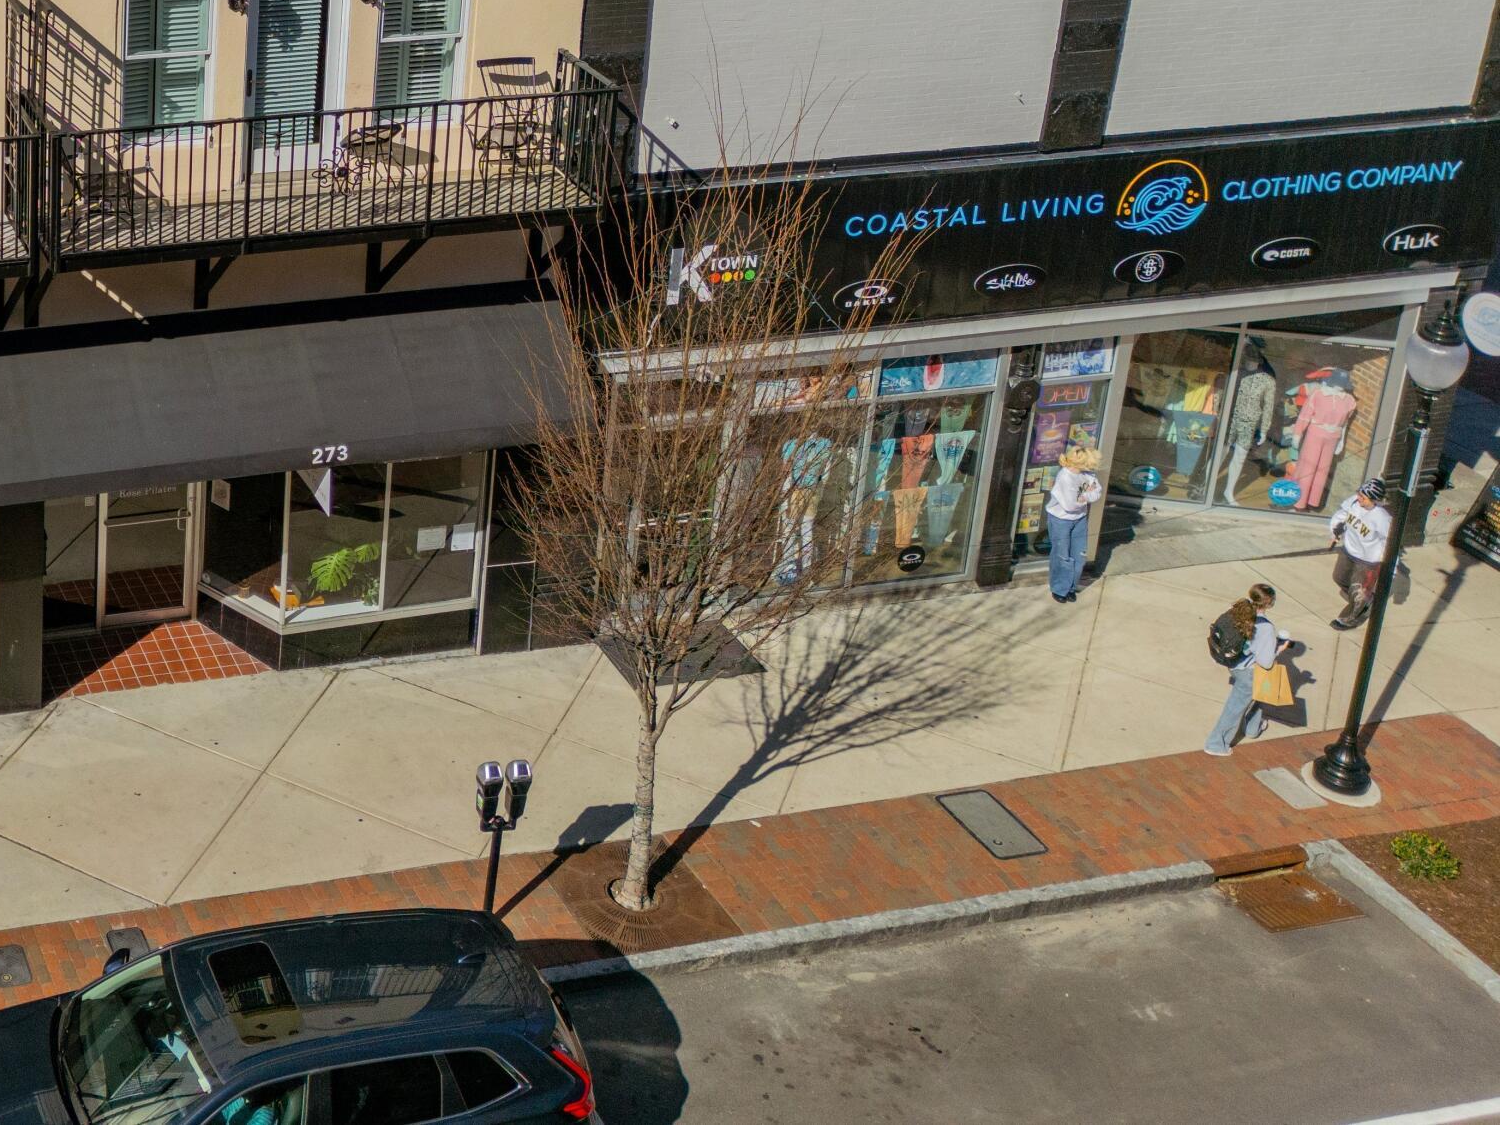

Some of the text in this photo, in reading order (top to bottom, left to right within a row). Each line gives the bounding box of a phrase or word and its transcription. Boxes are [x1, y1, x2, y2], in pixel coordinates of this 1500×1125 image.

[1222, 160, 1463, 202] CLOTHING COMPANY
[844, 193, 1105, 237] COASTAL LIVING
[1279, 248, 1312, 259] COSTA
[666, 244, 758, 306] K TOWN
[845, 296, 896, 308] OAKLEY
[1043, 384, 1088, 405] OPEN
[311, 445, 349, 465] 273
